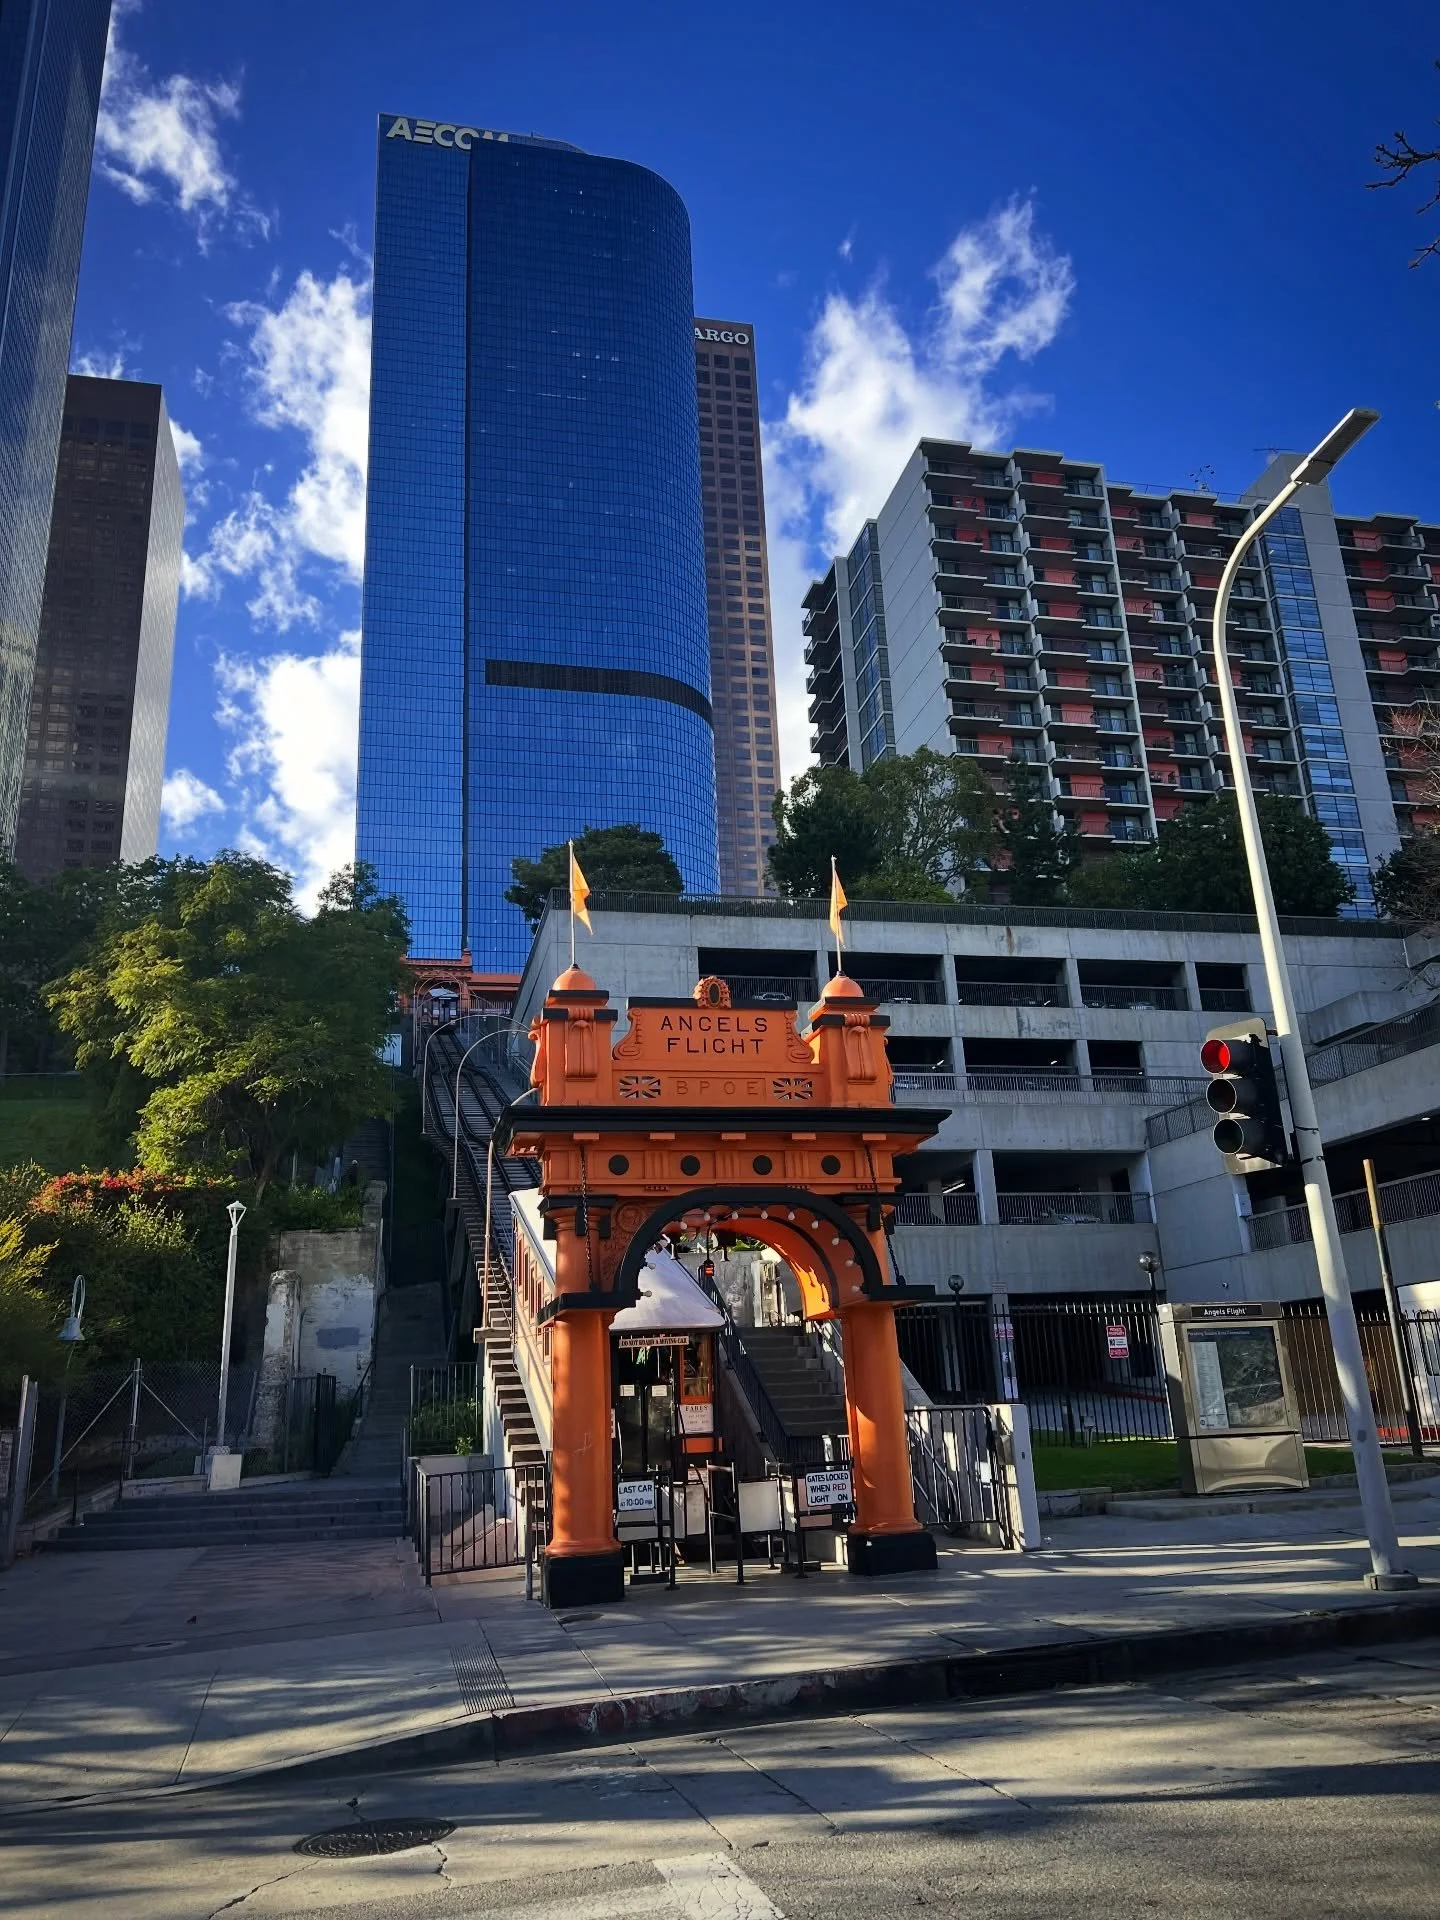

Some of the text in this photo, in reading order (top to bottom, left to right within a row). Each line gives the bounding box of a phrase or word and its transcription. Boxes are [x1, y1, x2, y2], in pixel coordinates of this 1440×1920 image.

[661, 1015, 768, 1033] ANGELS
[667, 1037, 765, 1055] FLIGHT
[1203, 1307, 1246, 1317] Angels Flight
[807, 1472, 849, 1483] GATES LOCKED
[618, 1484, 653, 1495] LAST CAR
[810, 1483, 847, 1493] WHEN RED
[626, 1497, 644, 1507] 10:00
[810, 1493, 849, 1504] LIGHT ON
